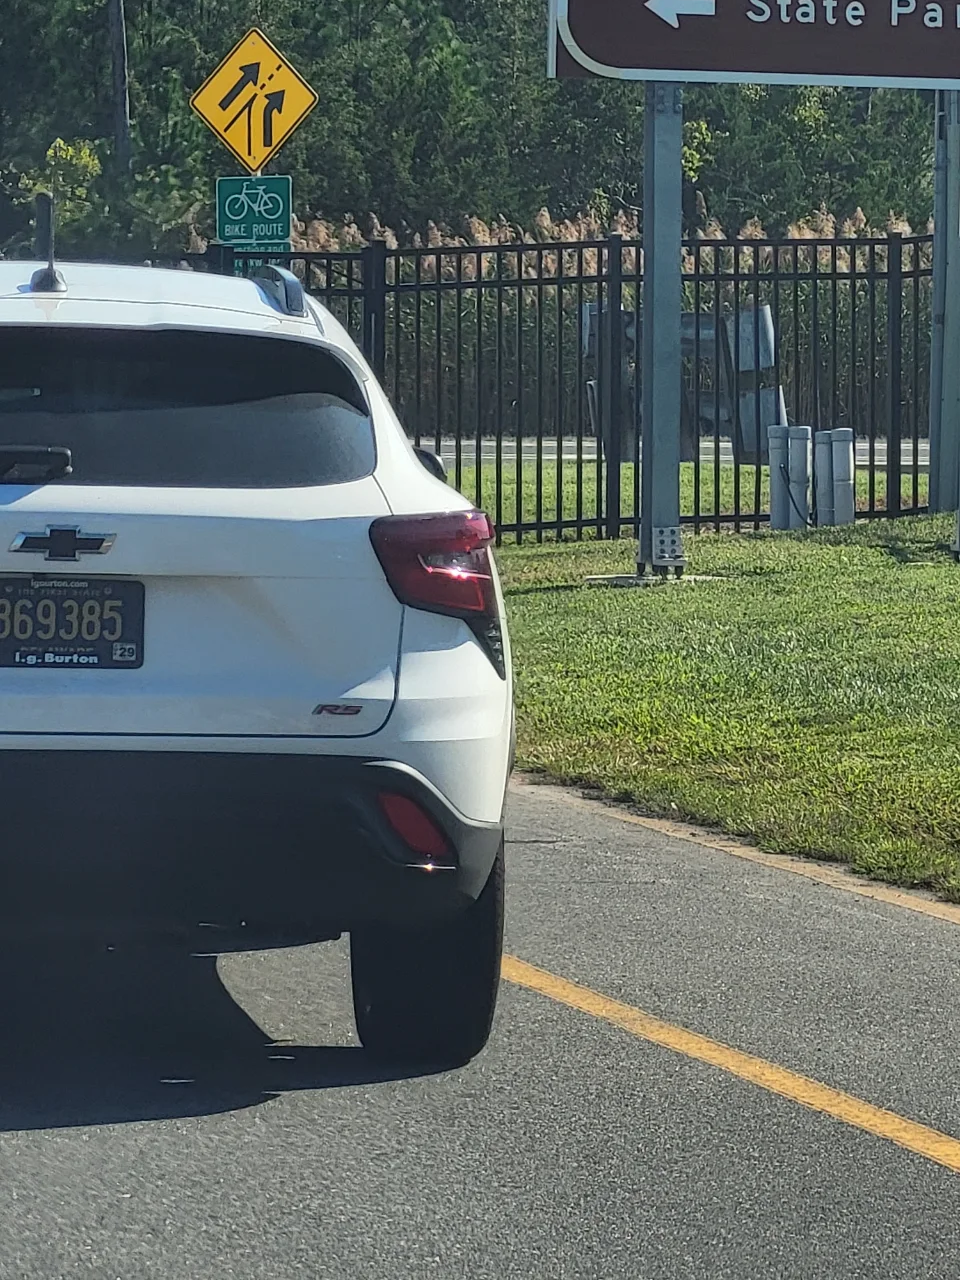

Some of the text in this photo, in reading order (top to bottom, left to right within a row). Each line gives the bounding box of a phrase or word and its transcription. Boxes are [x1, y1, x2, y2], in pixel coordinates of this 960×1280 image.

[224, 222, 284, 237] BIKE ROUTE
[44, 652, 98, 663] Burton
[119, 647, 135, 657] 29
[312, 704, 363, 715] RS
